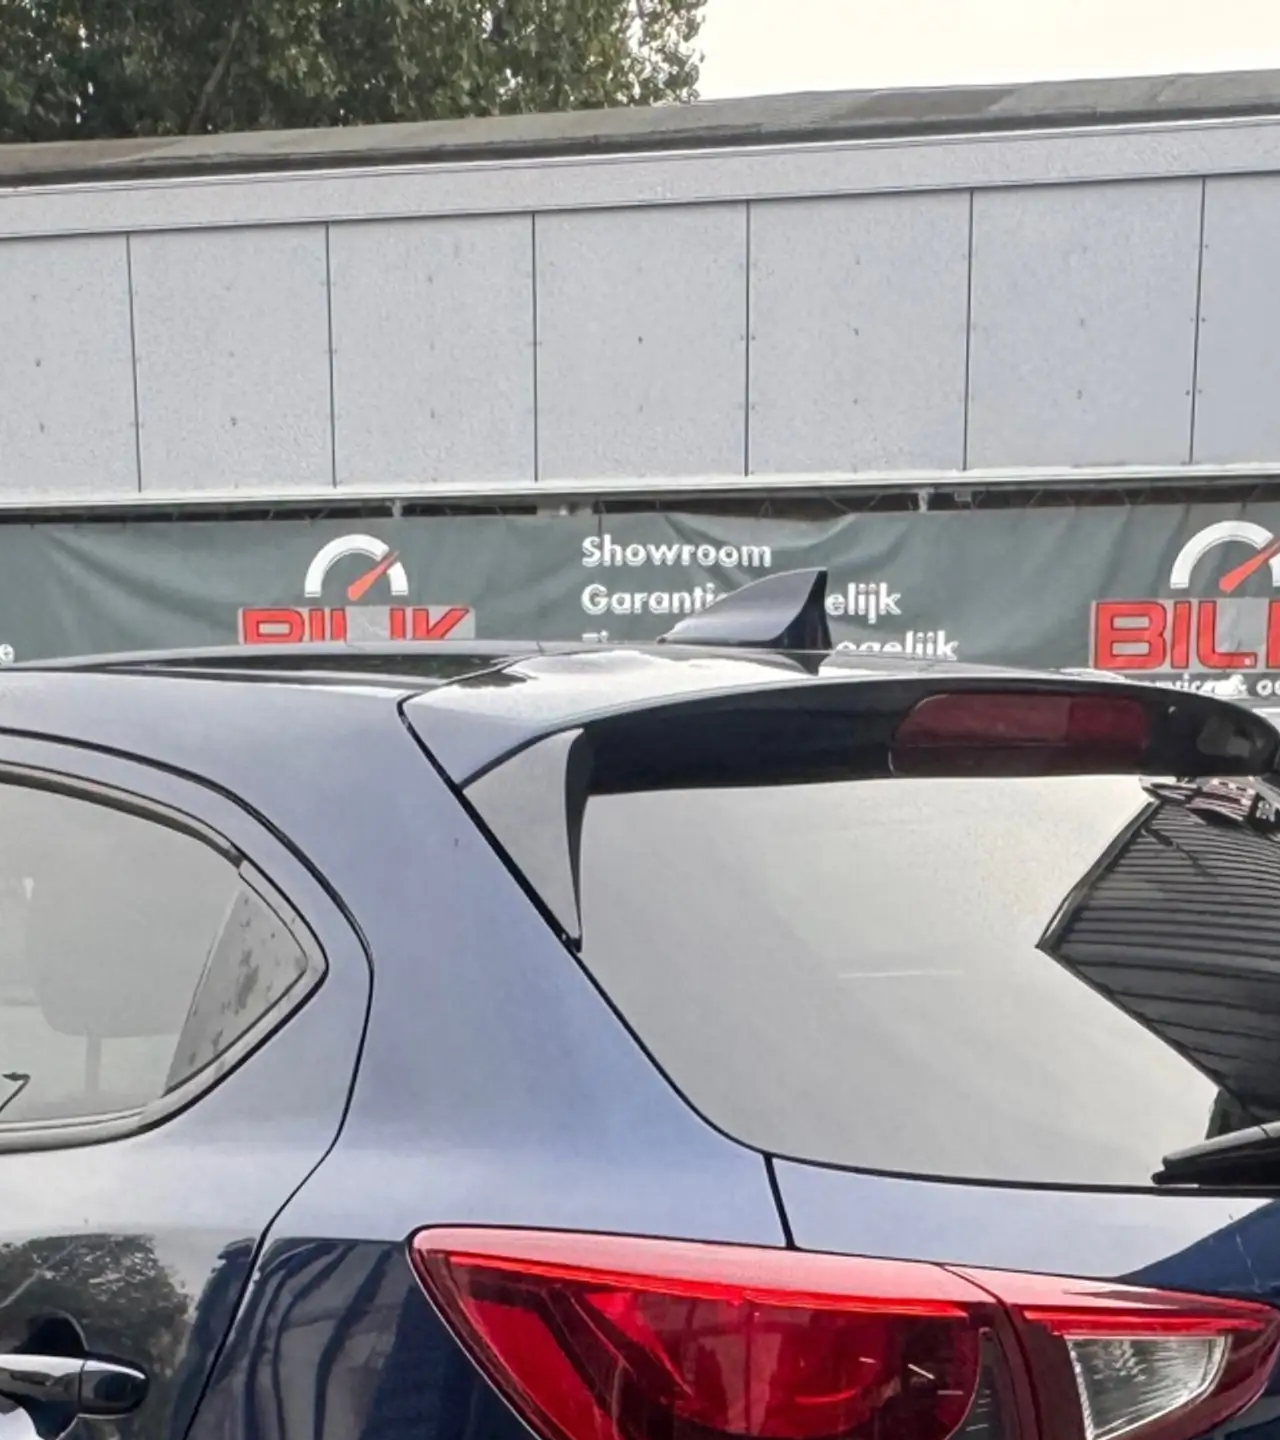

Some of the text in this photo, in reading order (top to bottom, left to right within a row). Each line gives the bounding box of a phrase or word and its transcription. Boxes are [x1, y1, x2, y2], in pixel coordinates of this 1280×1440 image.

[582, 533, 771, 567] Showroom
[581, 582, 902, 624] Garanti elijk
